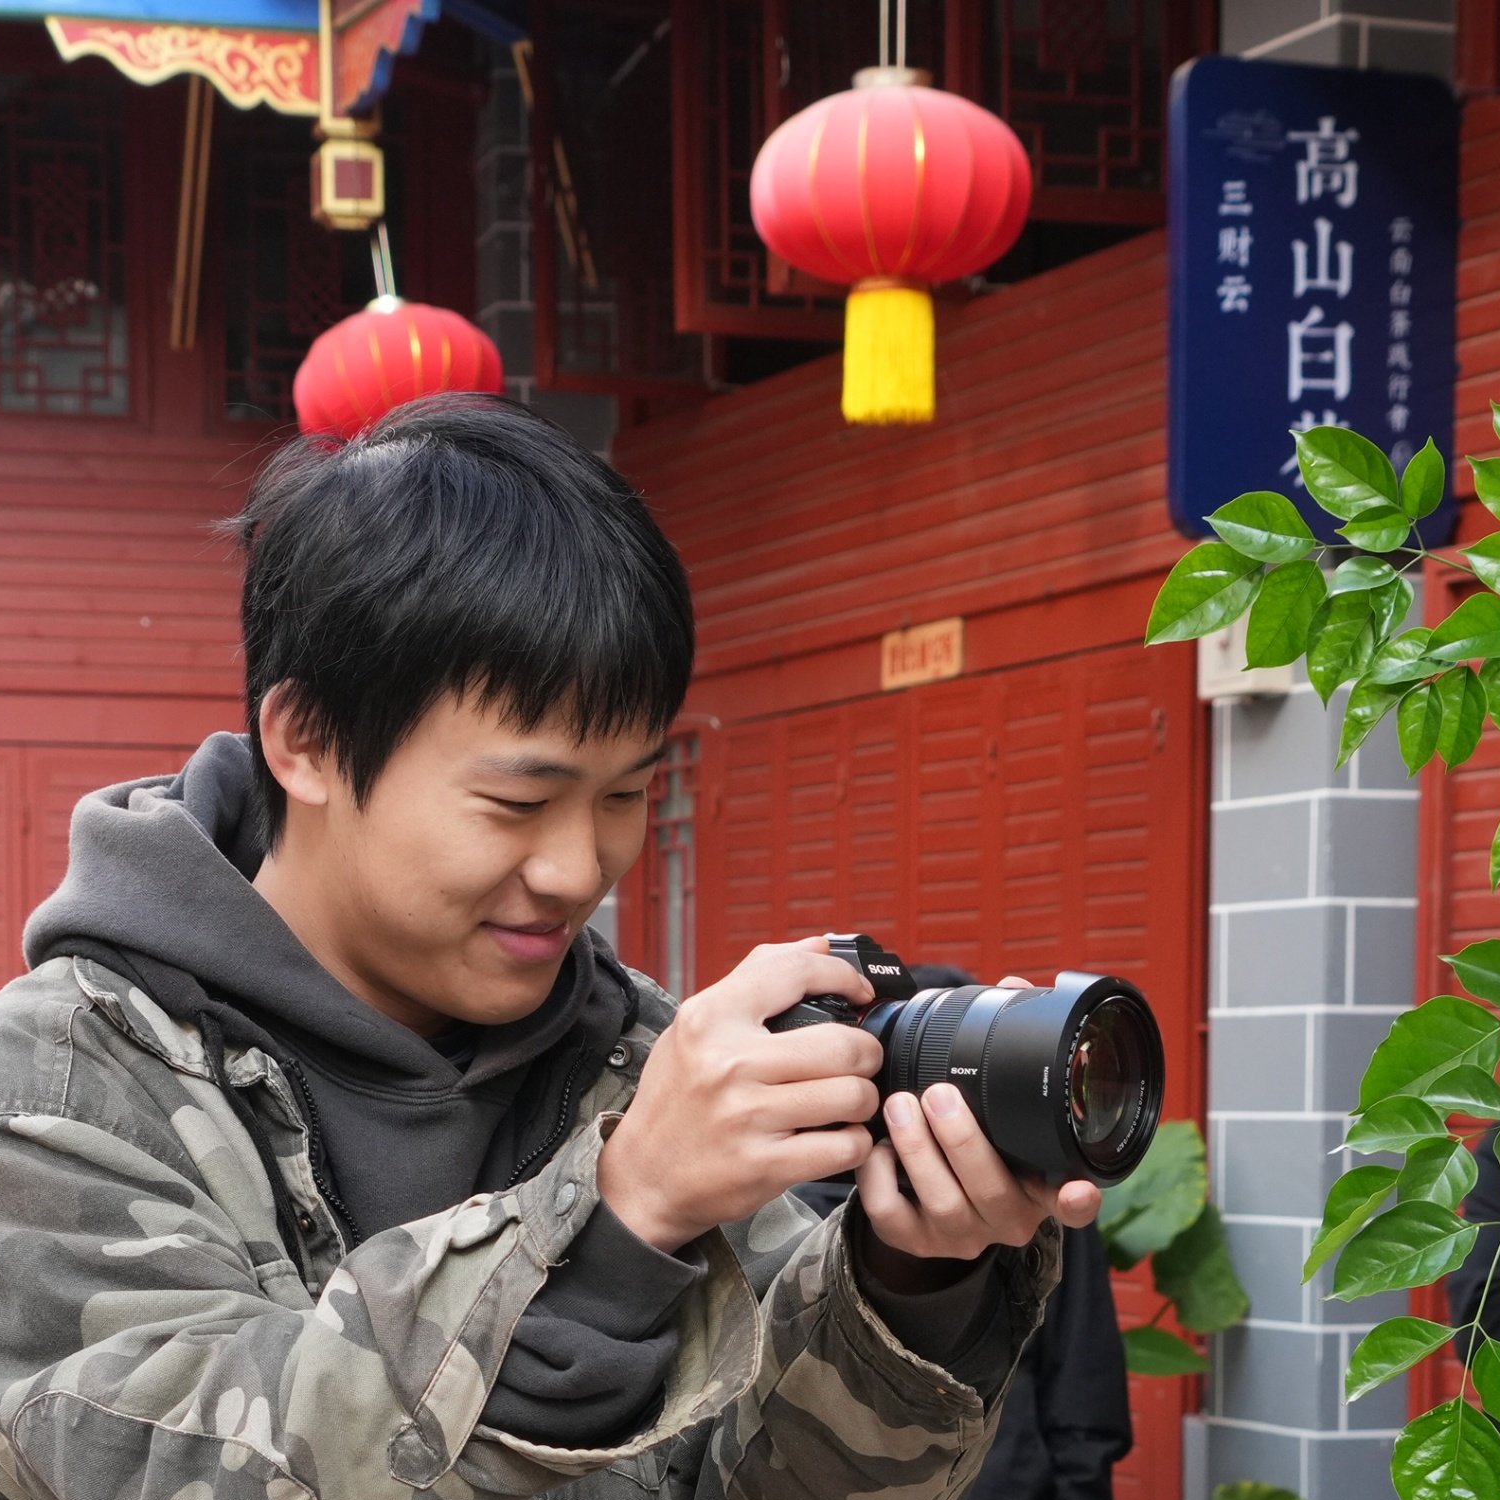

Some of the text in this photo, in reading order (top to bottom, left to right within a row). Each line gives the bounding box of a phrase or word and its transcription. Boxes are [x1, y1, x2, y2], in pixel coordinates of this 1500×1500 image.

[1217, 180, 1253, 313] 三财云
[868, 964, 901, 976] SONY
[951, 1067, 978, 1075] SONY
